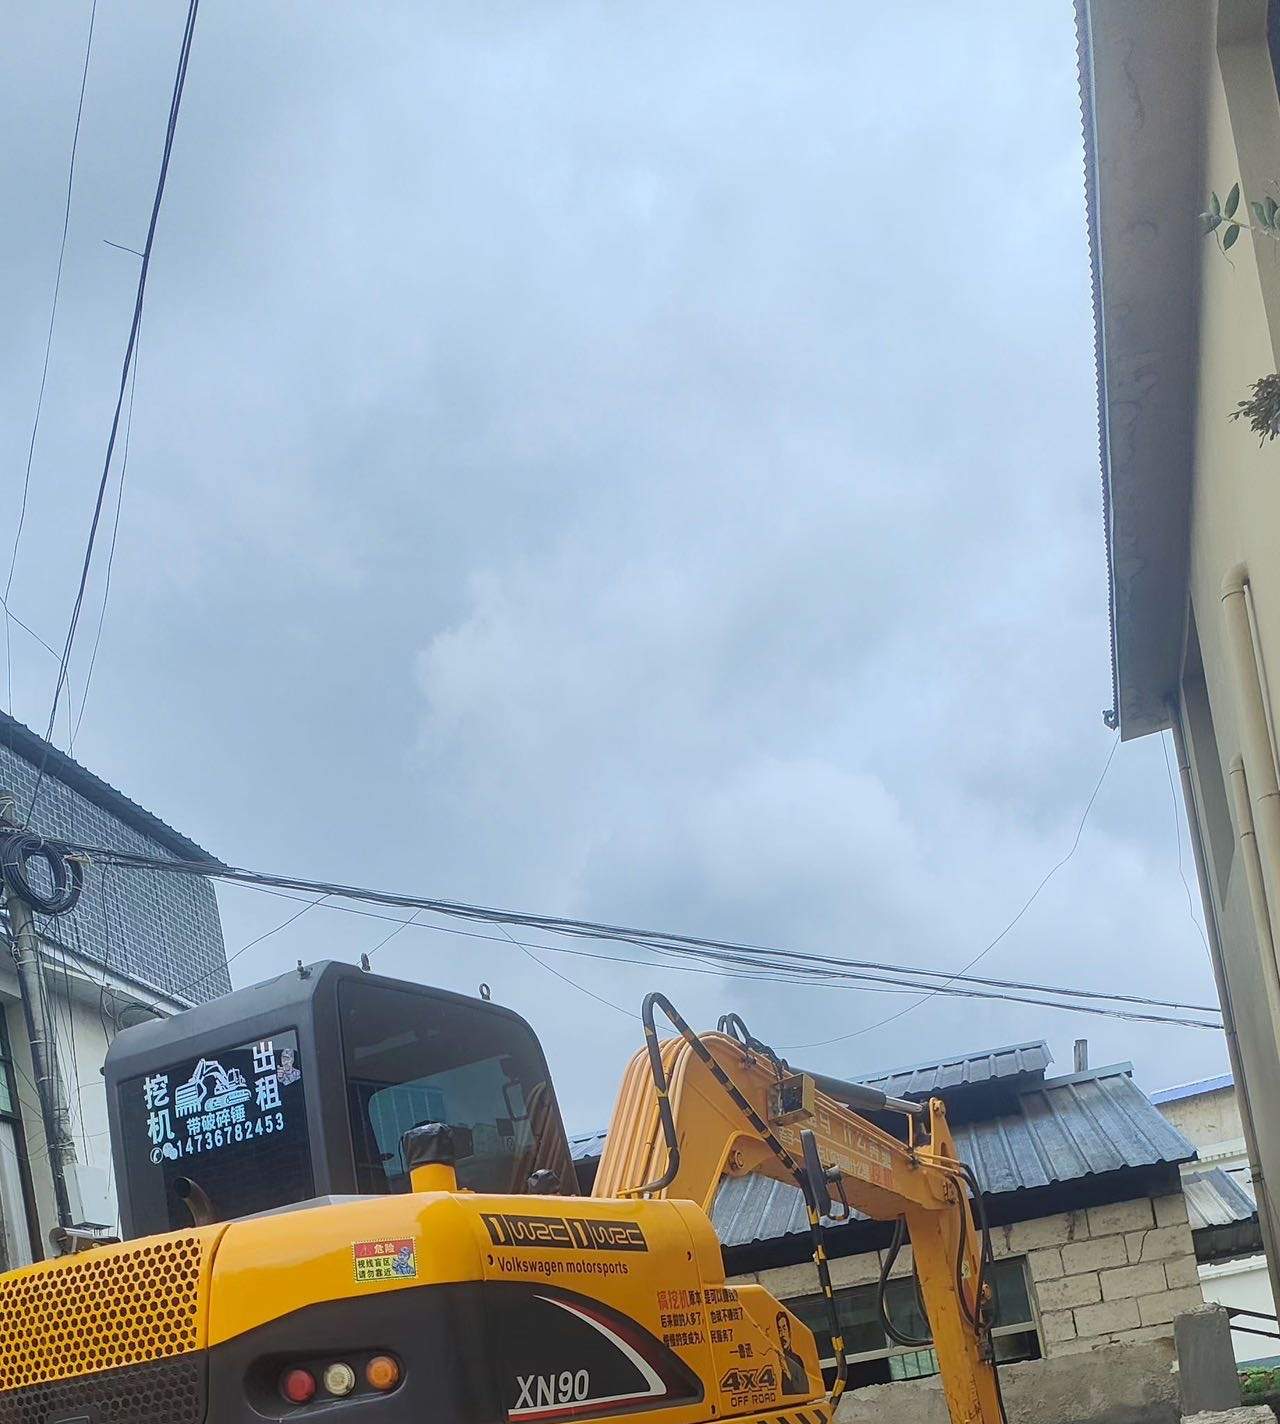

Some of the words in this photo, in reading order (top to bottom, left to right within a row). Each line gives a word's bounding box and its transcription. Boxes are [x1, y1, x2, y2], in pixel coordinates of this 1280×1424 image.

[252, 1041, 282, 1112] 出租
[143, 1073, 175, 1144] 挖机
[186, 1105, 246, 1136] 带破碎锤
[177, 1112, 284, 1158] 14736782453
[357, 1257, 391, 1269] 视线盲区
[373, 1243, 395, 1254] 危险
[497, 1256, 564, 1277] Volkswagen
[566, 1259, 629, 1278] motorsports
[514, 1369, 590, 1409] XN90
[730, 1395, 748, 1407] OFF
[751, 1392, 776, 1405] ROAD
